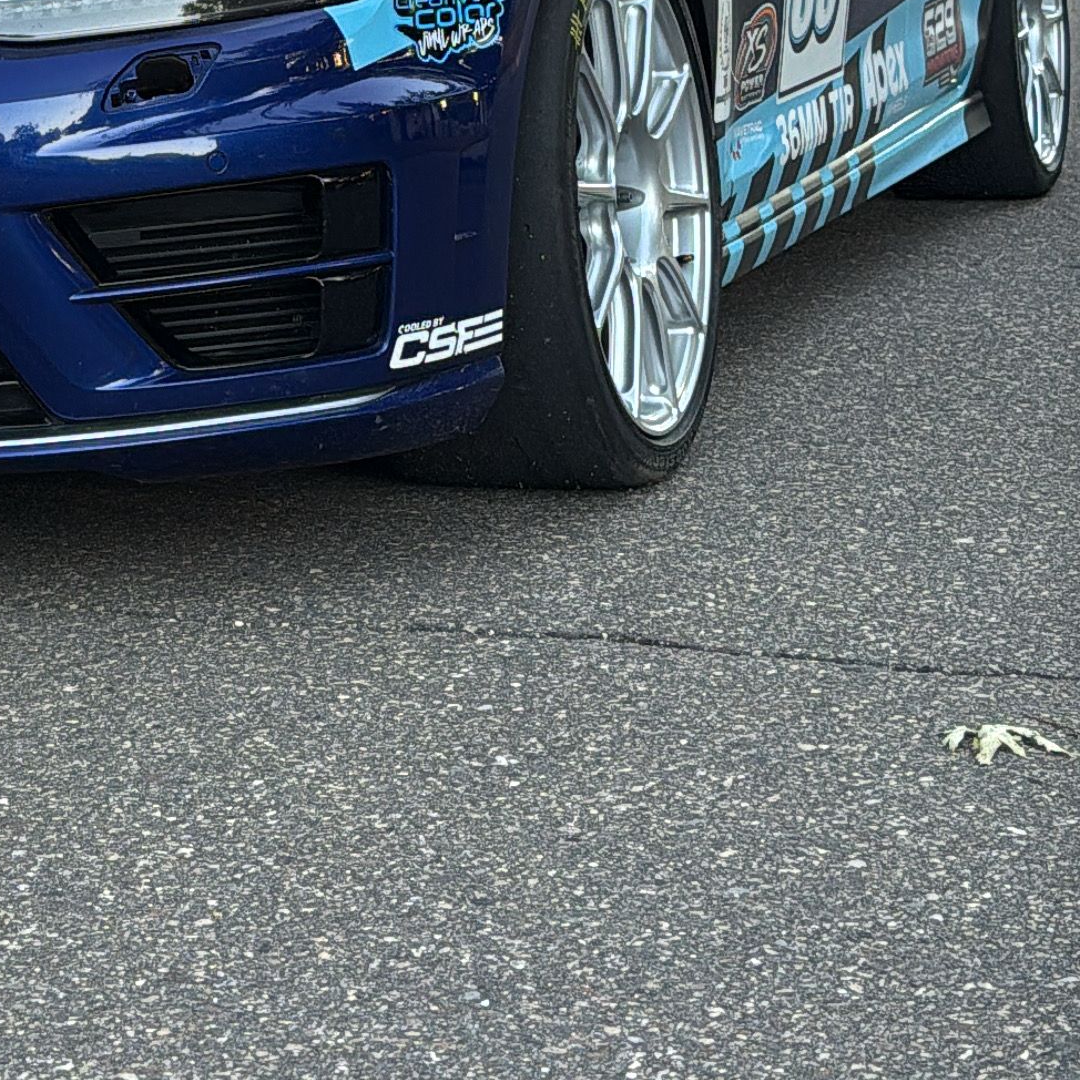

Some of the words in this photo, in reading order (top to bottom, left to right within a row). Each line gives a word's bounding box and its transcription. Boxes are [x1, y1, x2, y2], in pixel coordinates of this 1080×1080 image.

[415, 0, 496, 30] color
[776, 95, 828, 167] 36MM
[863, 33, 909, 125] Apex
[398, 319, 432, 335] COOLED
[432, 316, 445, 327] BY
